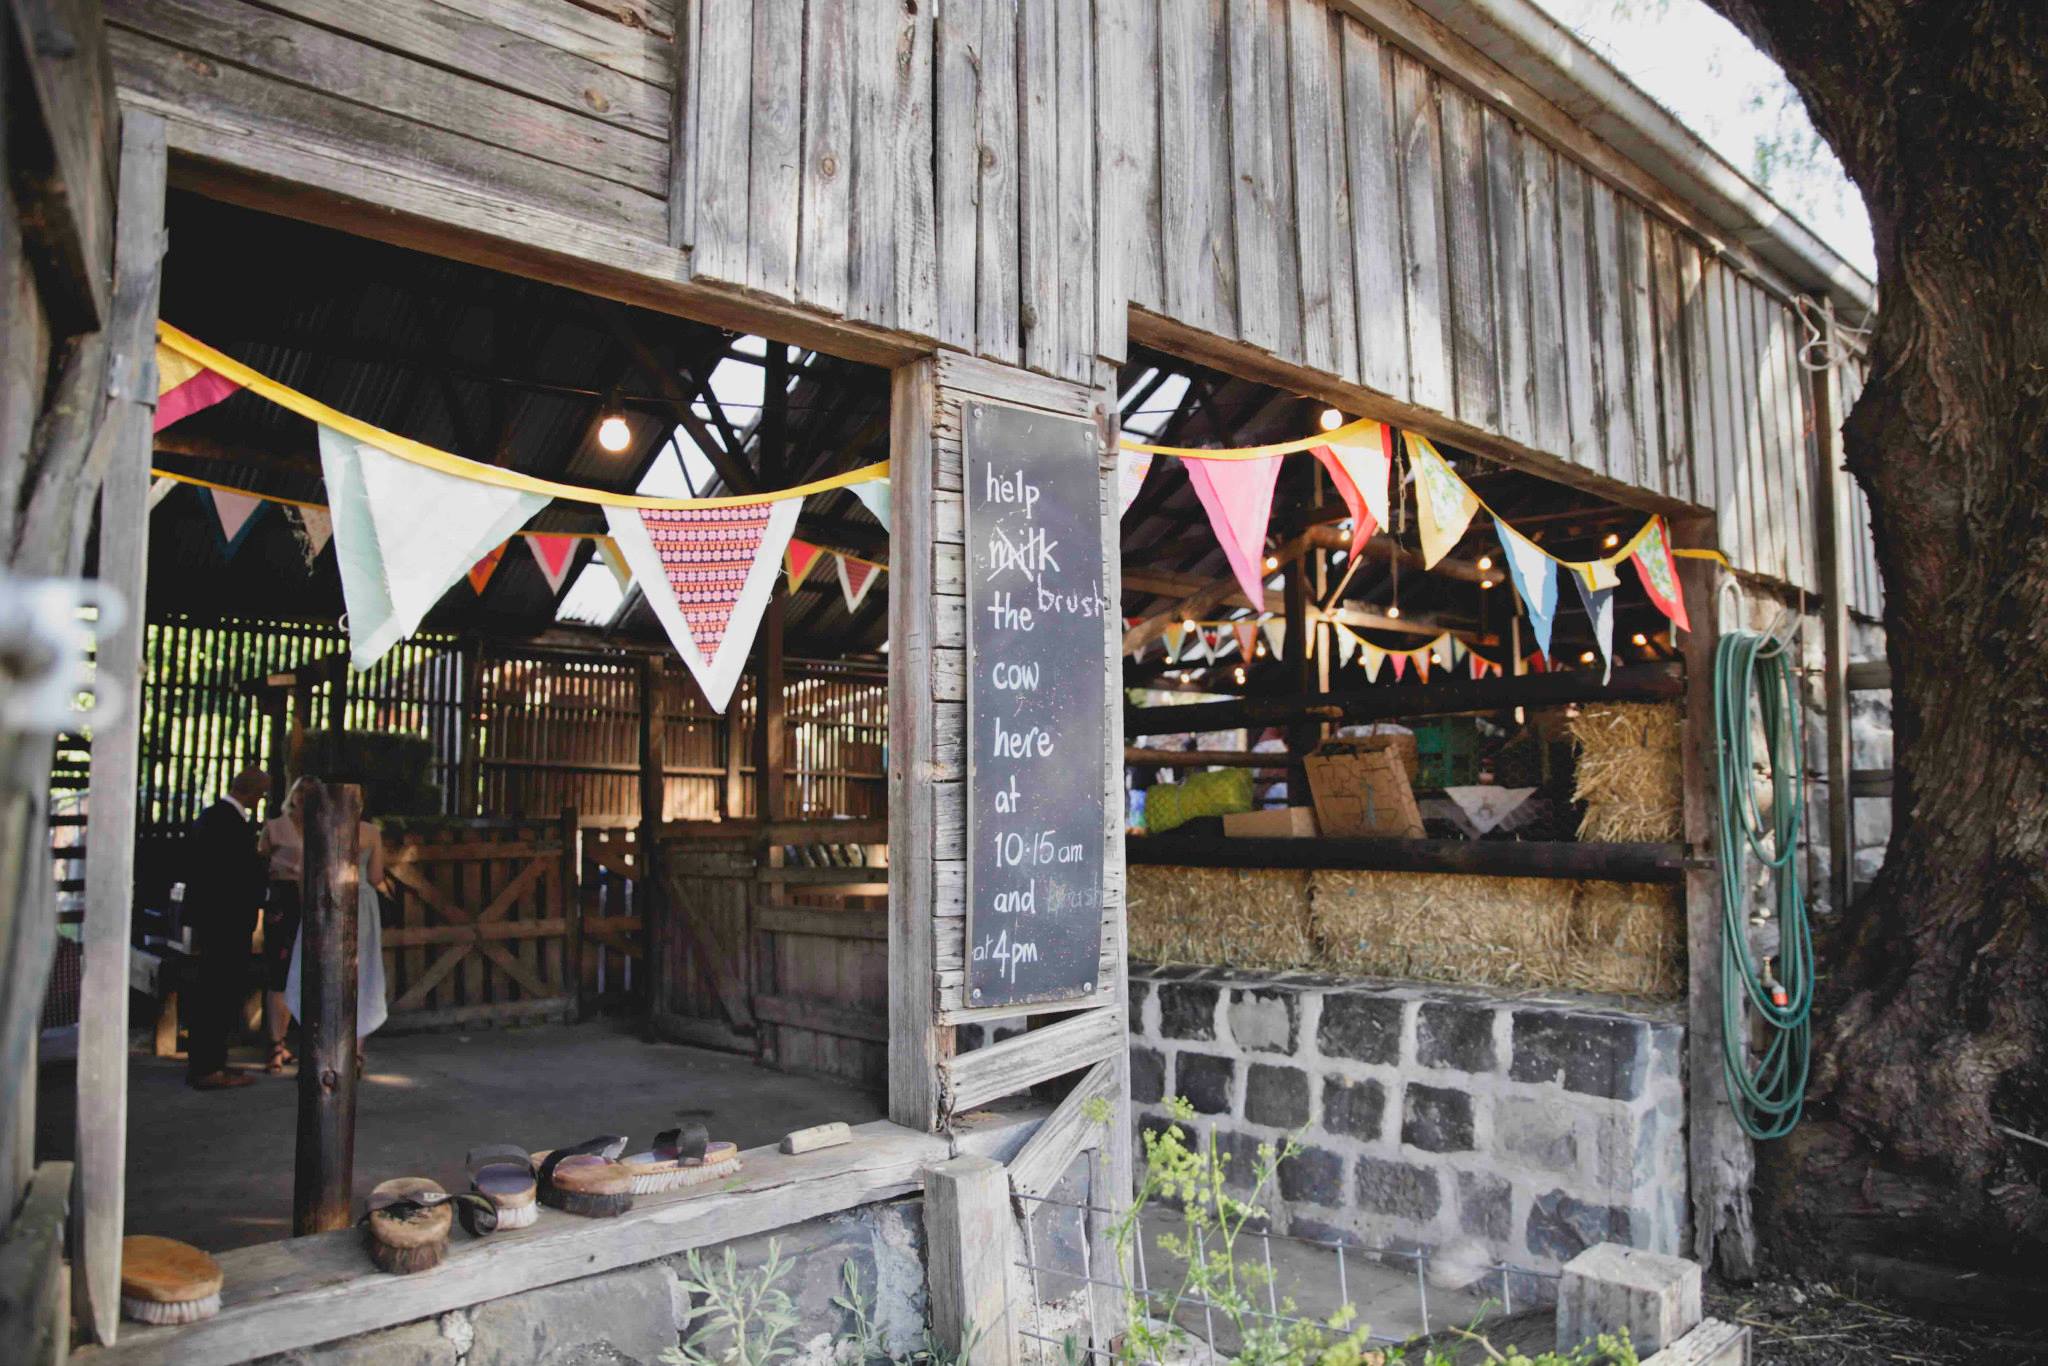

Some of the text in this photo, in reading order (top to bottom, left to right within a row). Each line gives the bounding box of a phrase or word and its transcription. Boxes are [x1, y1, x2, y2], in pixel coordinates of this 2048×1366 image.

[987, 462, 1040, 519] help
[987, 591, 1035, 631] the
[1037, 573, 1104, 618] brush
[992, 662, 1040, 691] cow
[993, 717, 1054, 758] here
[995, 775, 1021, 813] at
[994, 878, 1036, 914] and
[974, 934, 993, 960] at
